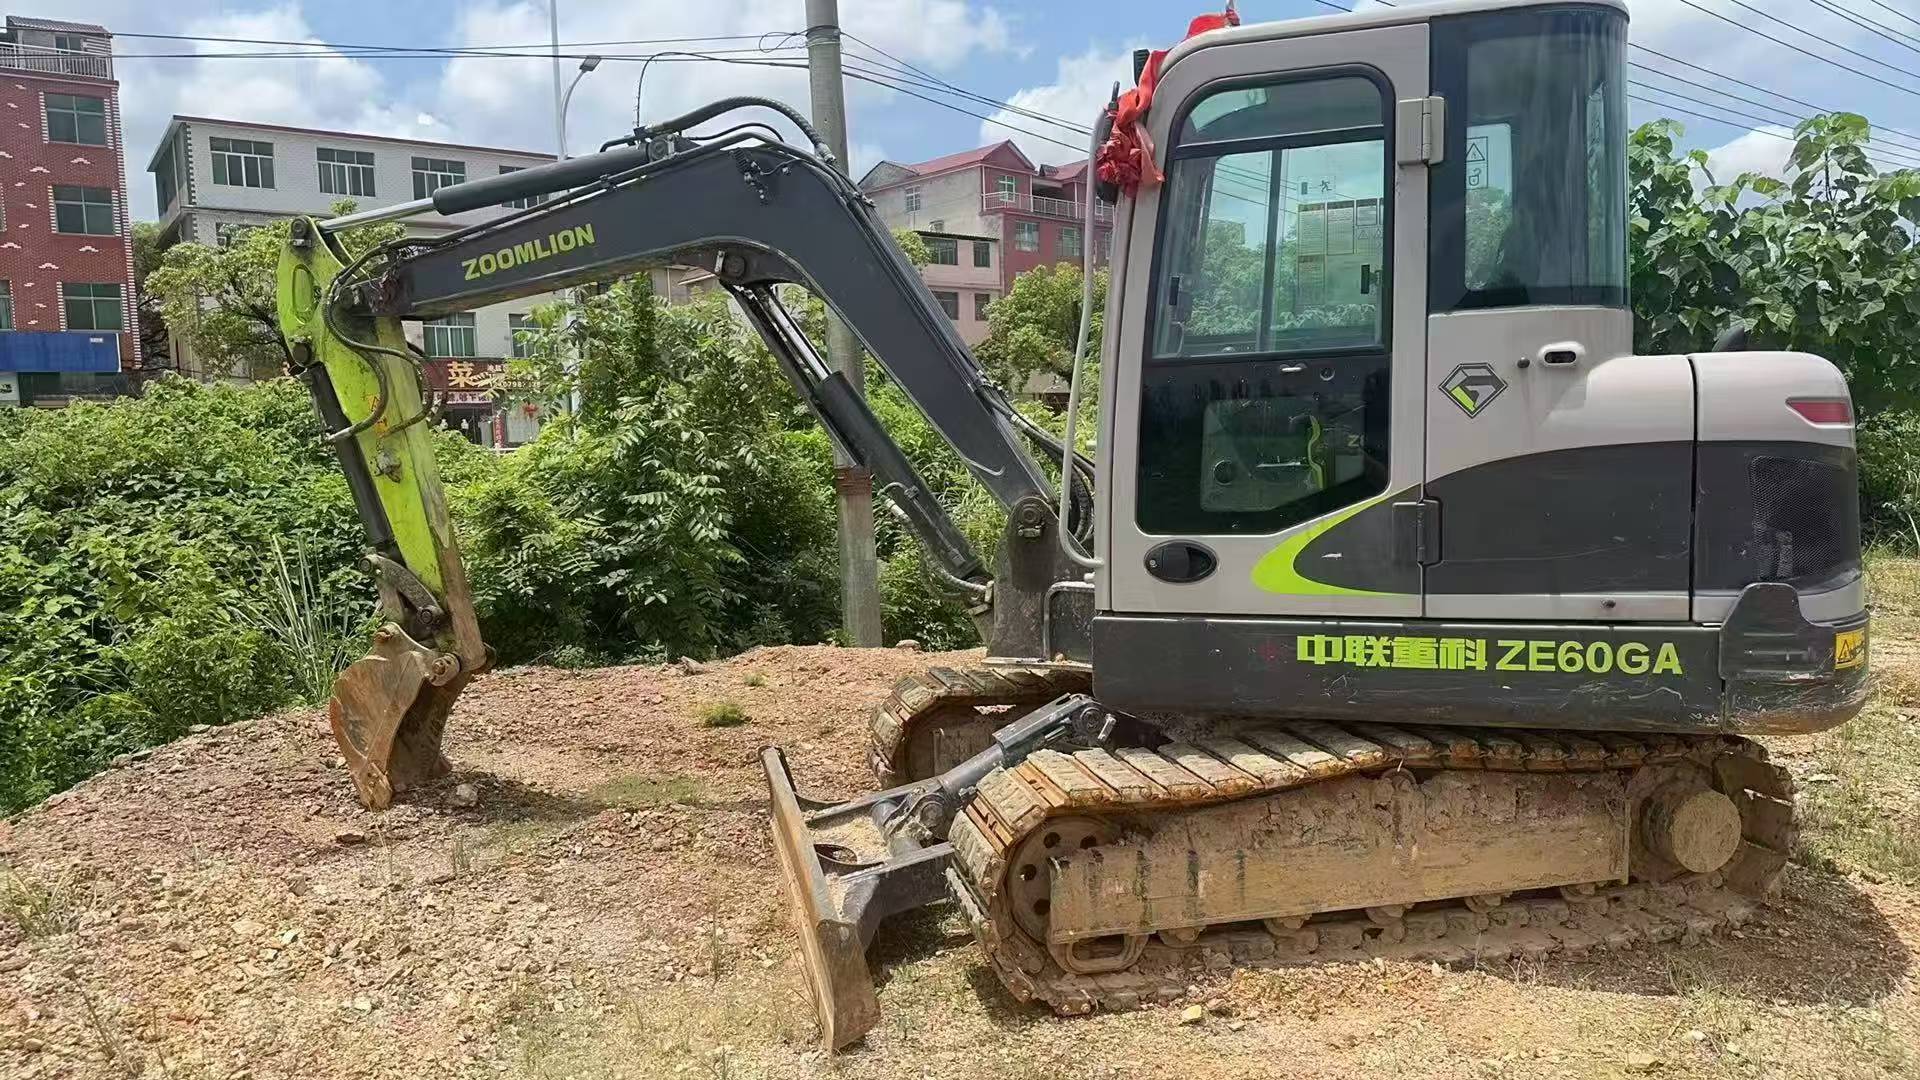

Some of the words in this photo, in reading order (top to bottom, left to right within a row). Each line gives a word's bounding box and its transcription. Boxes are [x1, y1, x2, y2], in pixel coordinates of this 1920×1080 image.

[461, 223, 596, 281] ZOOMLION
[447, 361, 476, 388] 菜
[1296, 634, 1488, 671] 中联重科
[1495, 639, 1683, 675] ZE60GA
